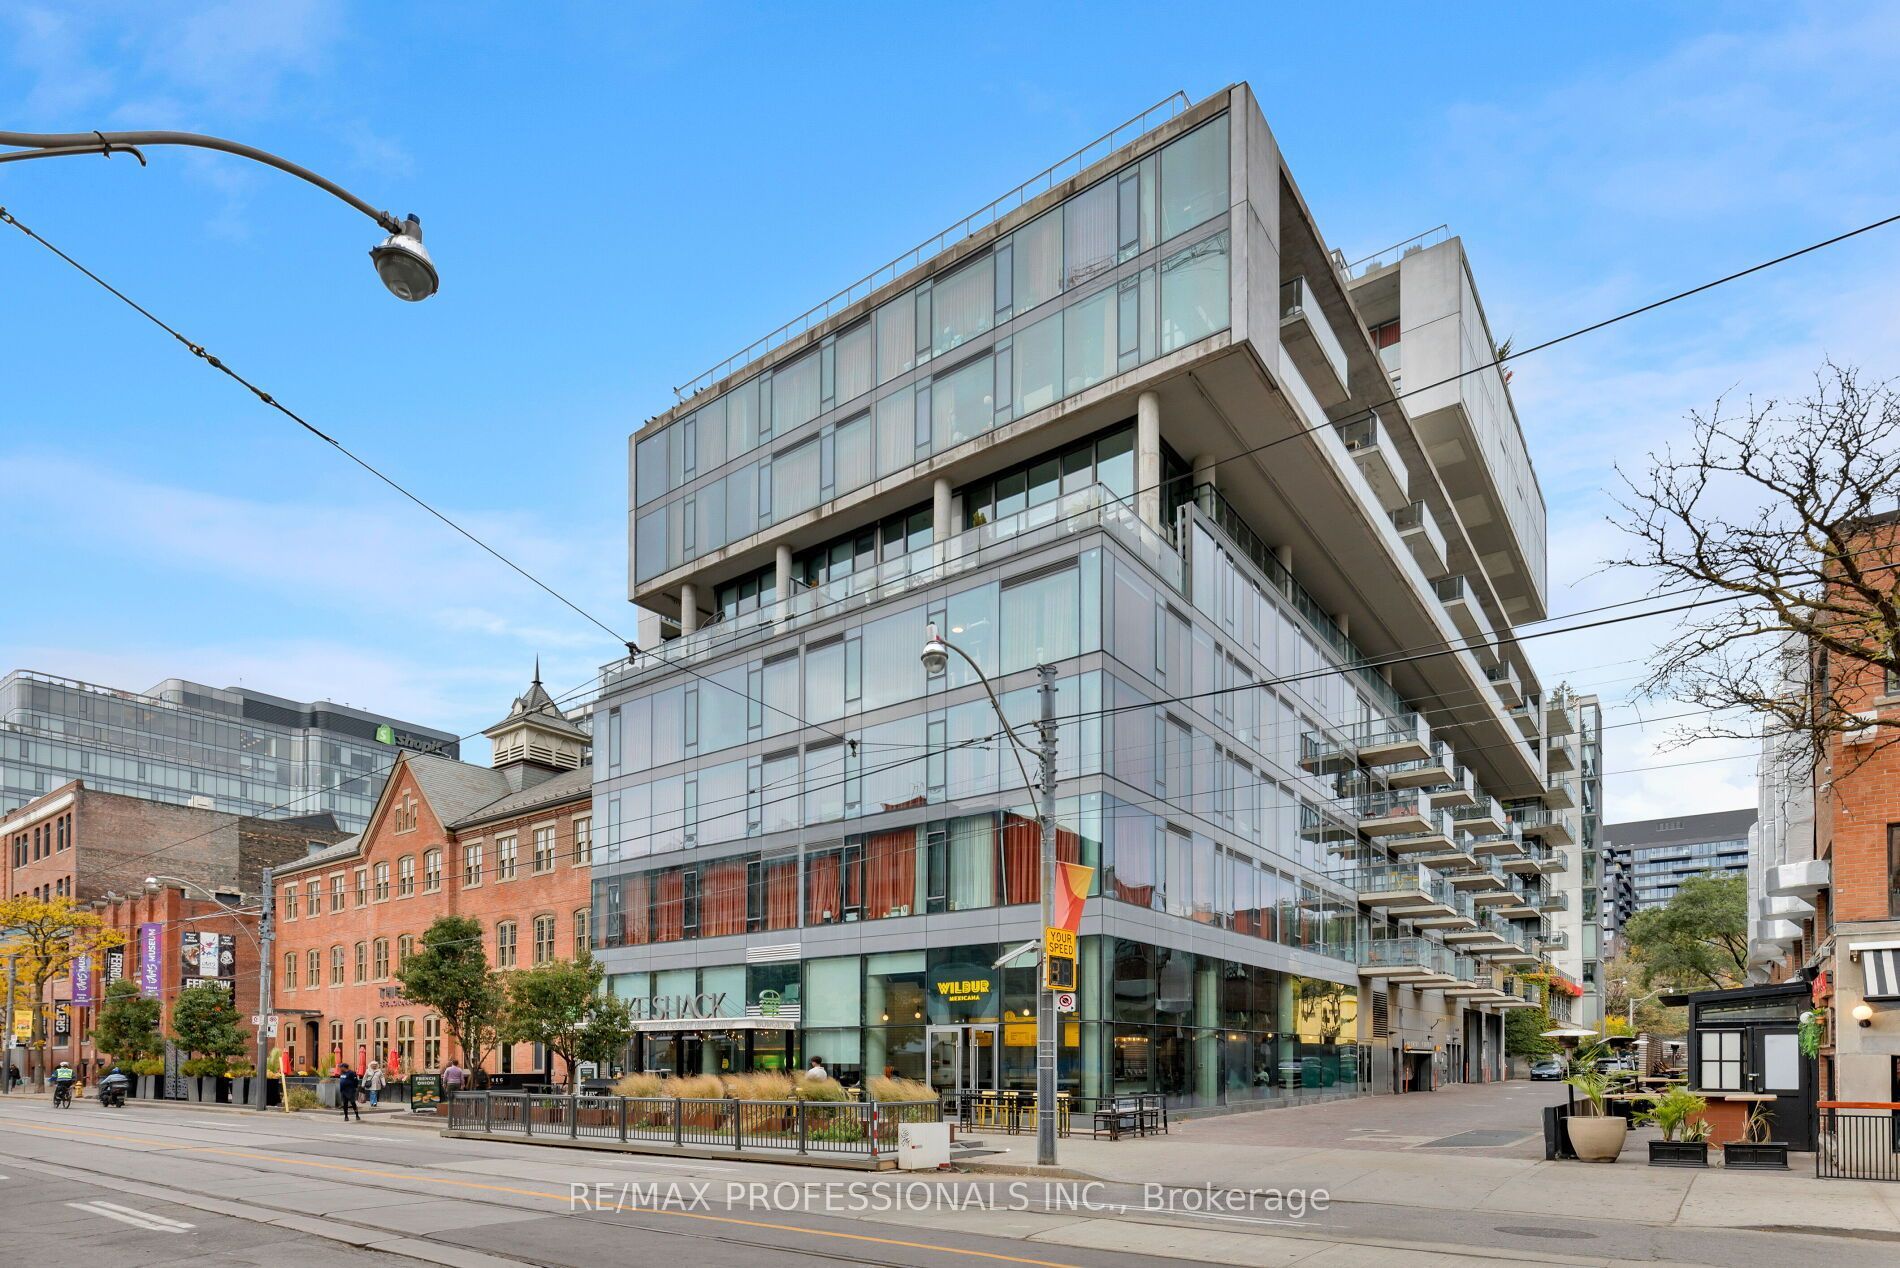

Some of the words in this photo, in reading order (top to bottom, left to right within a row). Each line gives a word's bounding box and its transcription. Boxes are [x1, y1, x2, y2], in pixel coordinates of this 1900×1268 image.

[148, 928, 157, 962] MUSEUM
[1050, 931, 1072, 945] YOUR
[1049, 942, 1073, 955] SPEED
[937, 979, 990, 995] WILBUR
[651, 992, 727, 1020] SHACK
[949, 994, 980, 1002] MEXICANA
[55, 1003, 66, 1033] GRETA
